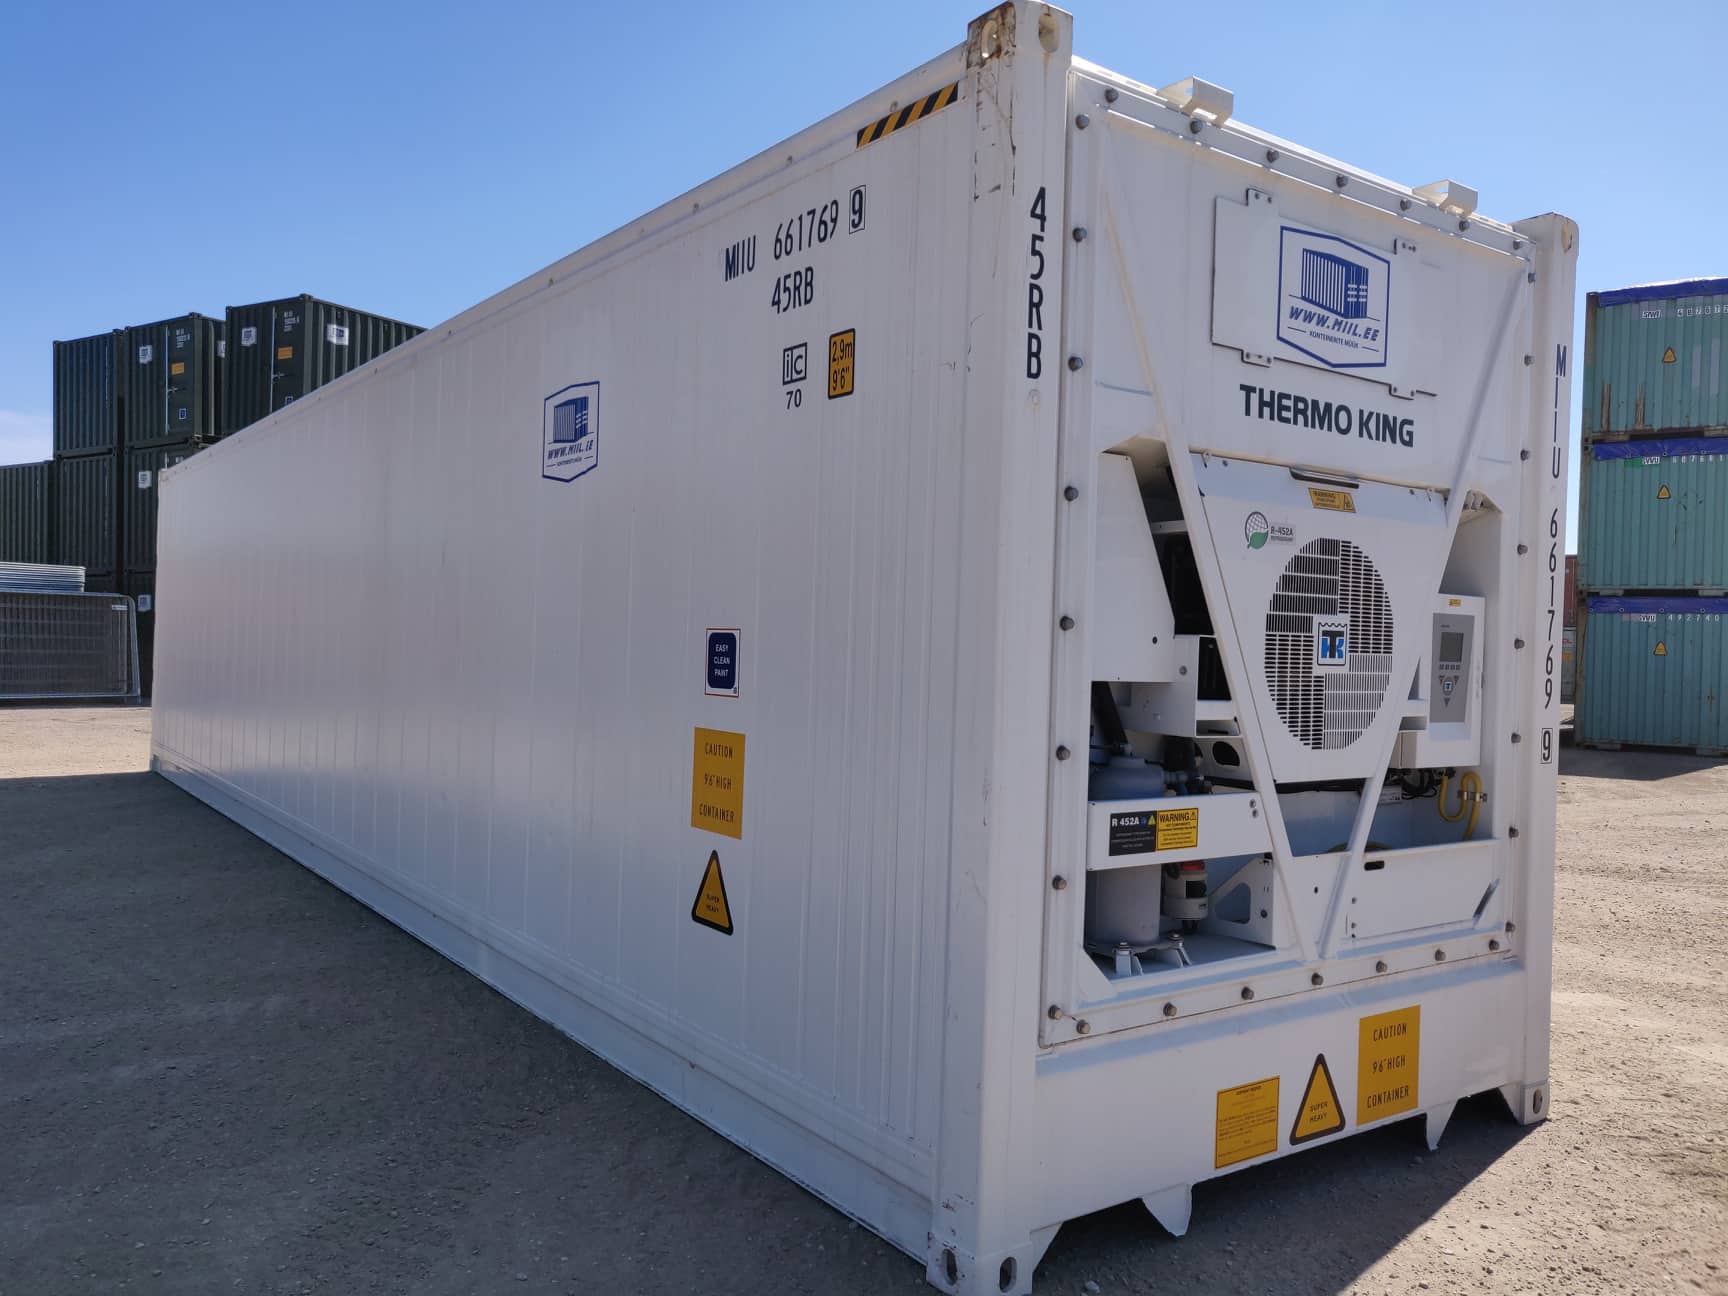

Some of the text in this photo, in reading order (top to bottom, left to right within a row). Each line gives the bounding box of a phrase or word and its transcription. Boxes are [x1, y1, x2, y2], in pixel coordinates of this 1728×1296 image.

[725, 188, 864, 281] MIIU 661769 9
[771, 266, 814, 314] 45RB
[1026, 186, 1047, 380] 45RB
[1288, 305, 1380, 341] WWW.MIIL.EE
[786, 388, 802, 410] 70
[1239, 383, 1415, 449] THERMO KING
[1552, 343, 1567, 479] MIIU
[547, 439, 594, 460] WWW.MIIL.EE
[1270, 525, 1294, 537] R-452A
[1545, 508, 1558, 710] 661769
[715, 643, 729, 653] EASY
[713, 656, 730, 665] CLEAN
[714, 668, 729, 677] PAINT
[704, 742, 733, 760] CAUTION
[699, 803, 735, 824] CONTAINER
[1111, 816, 1139, 827] R 452A
[1159, 812, 1190, 823] WARNING
[1373, 1022, 1407, 1042] CAUTION
[1387, 1054, 1406, 1070] HIGH
[1309, 1101, 1328, 1112] SUPER
[1366, 1084, 1409, 1109] CONTAINER
